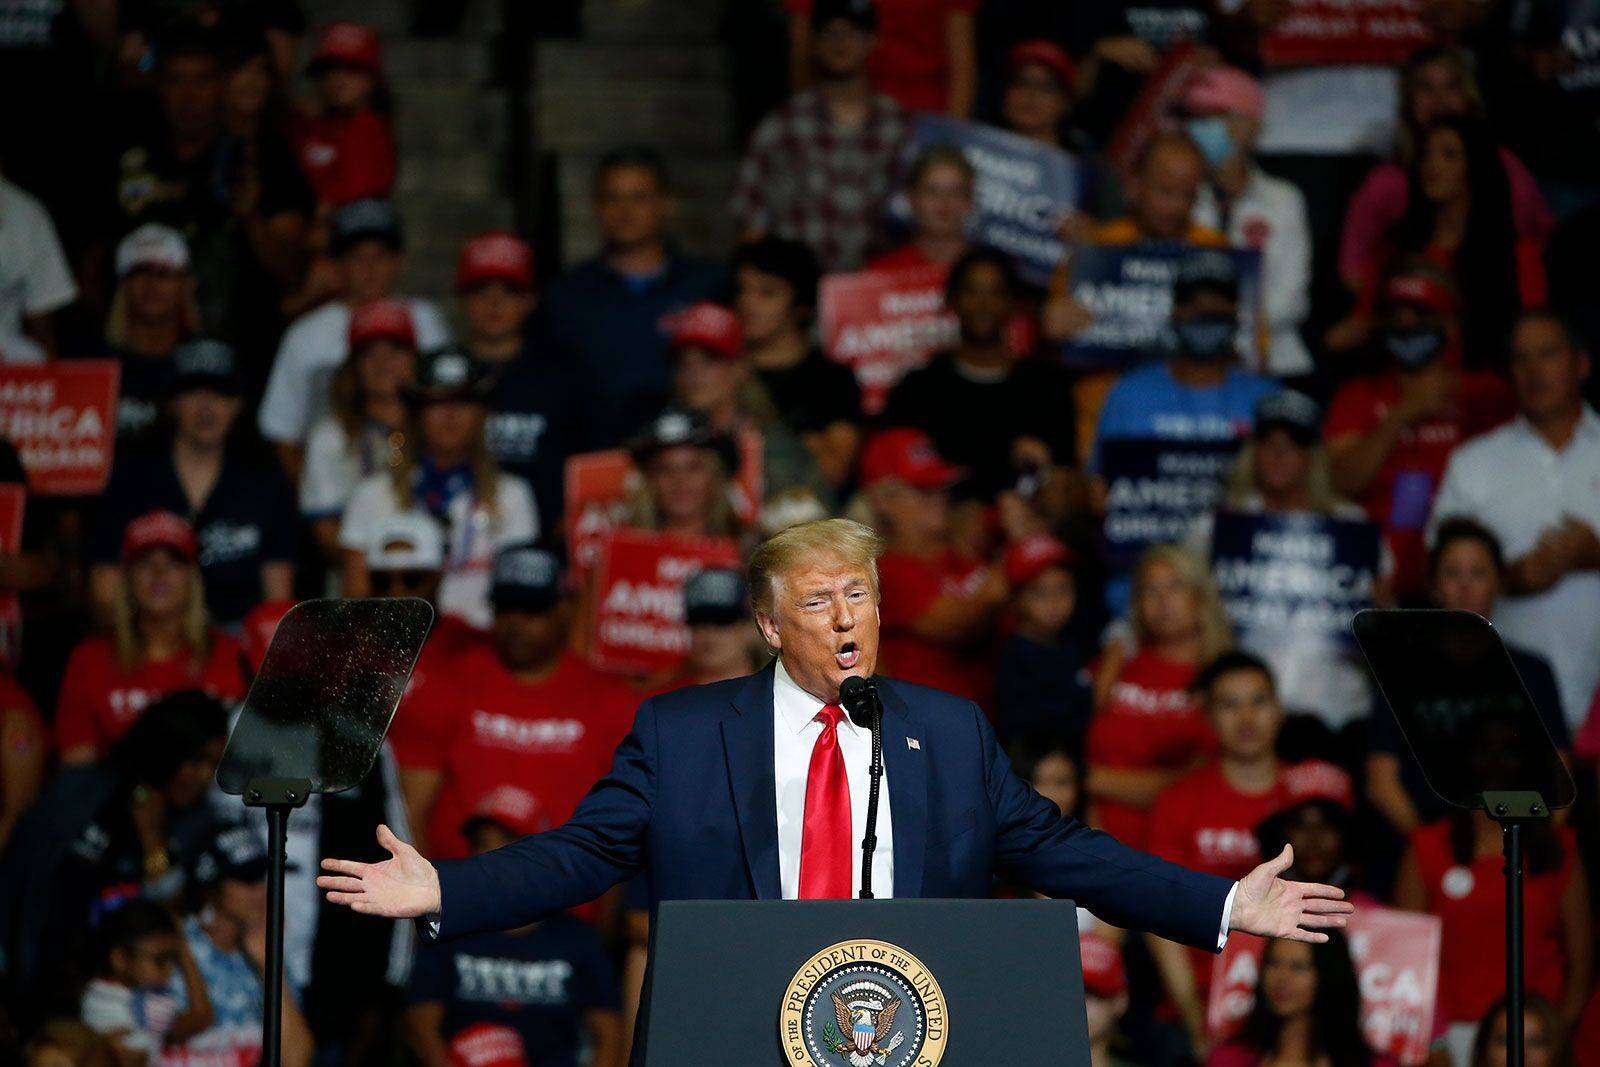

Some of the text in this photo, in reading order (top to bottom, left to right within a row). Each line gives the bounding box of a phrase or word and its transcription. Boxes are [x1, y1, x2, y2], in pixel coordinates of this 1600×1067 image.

[472, 709, 585, 746] TRUMP
[787, 945, 943, 1060] OF THE PRESIDENT OF THE UNITED
